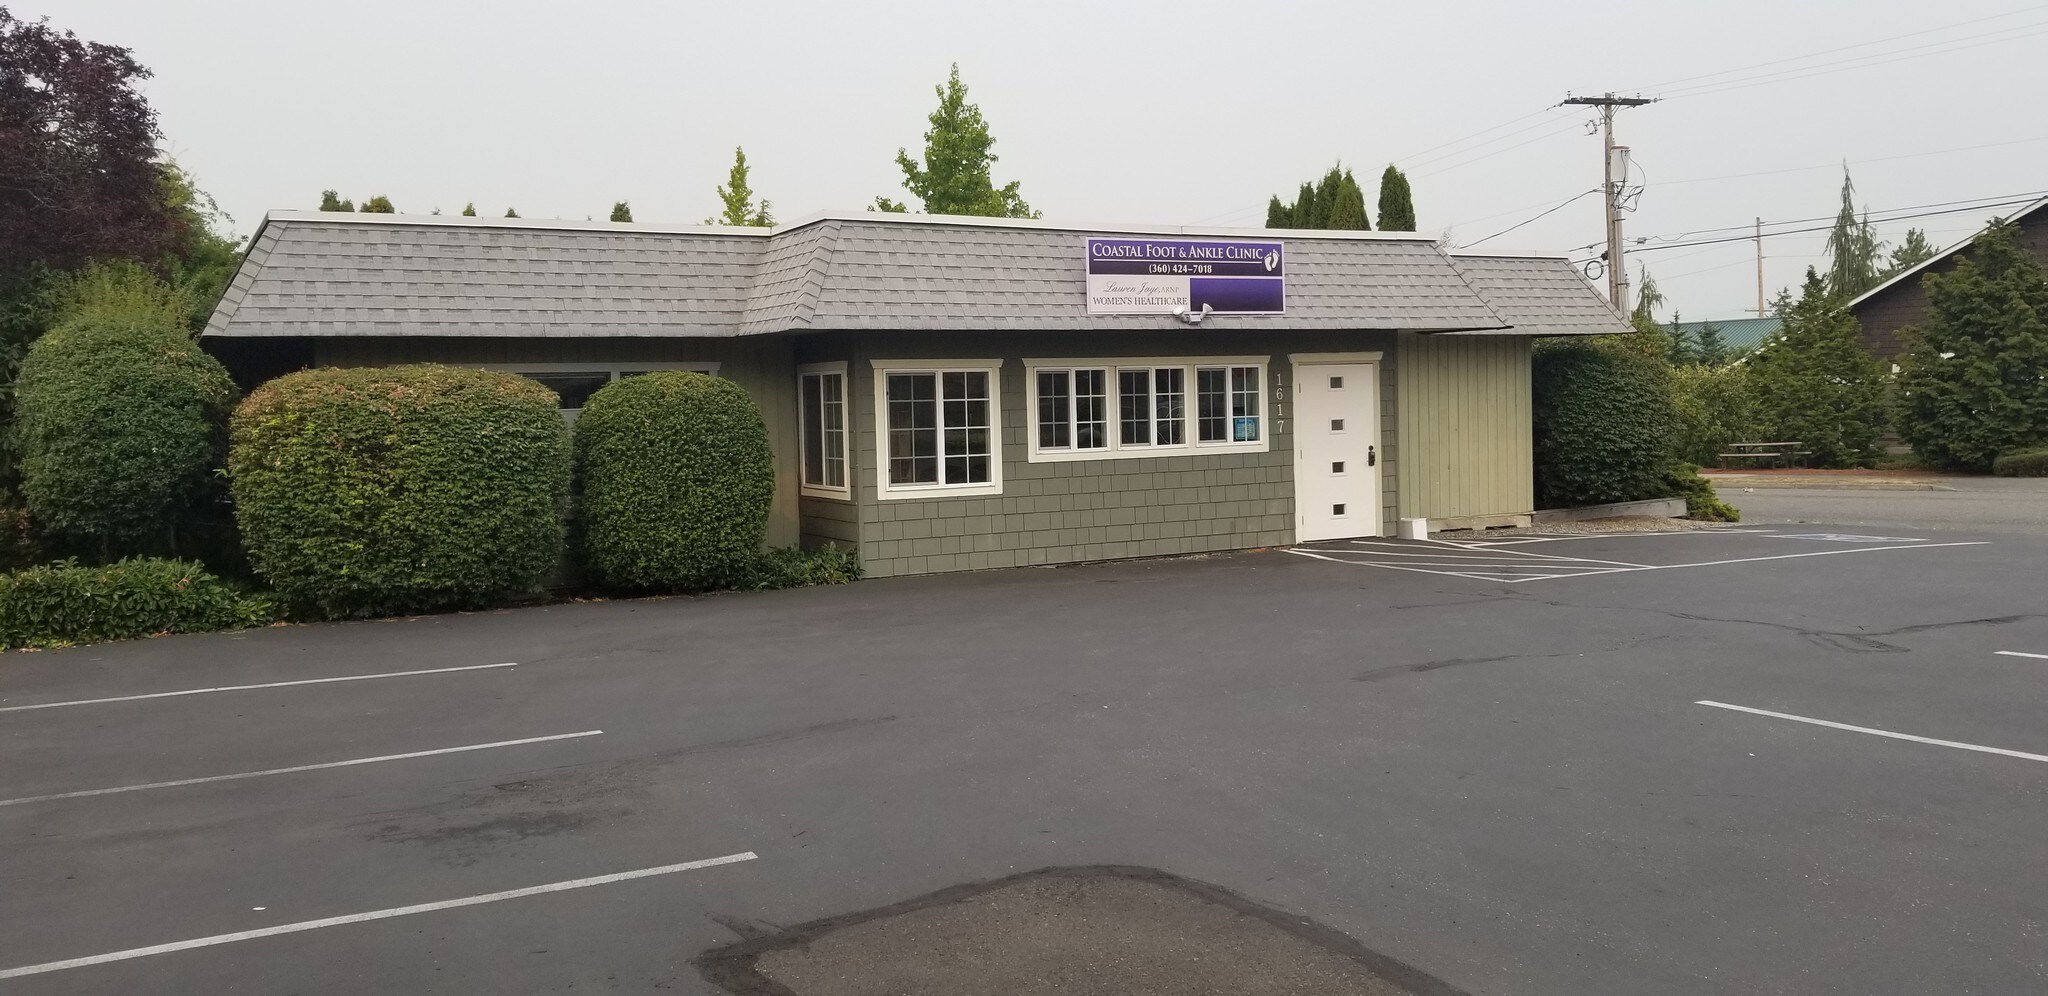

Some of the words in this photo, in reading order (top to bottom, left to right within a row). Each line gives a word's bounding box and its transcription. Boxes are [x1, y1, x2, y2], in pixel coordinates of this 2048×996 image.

[1092, 242, 1144, 257] COASTAL
[1146, 244, 1176, 258] FOOT
[1179, 249, 1187, 258] &
[1189, 245, 1224, 259] ANKLE
[1226, 246, 1263, 259] CLINIC
[1149, 264, 1171, 274] (360)
[1103, 281, 1137, 293] Lauren
[1093, 296, 1133, 305] WOMEN'S
[1134, 296, 1188, 306] HEALTHCARE
[1276, 373, 1285, 433] 1617
